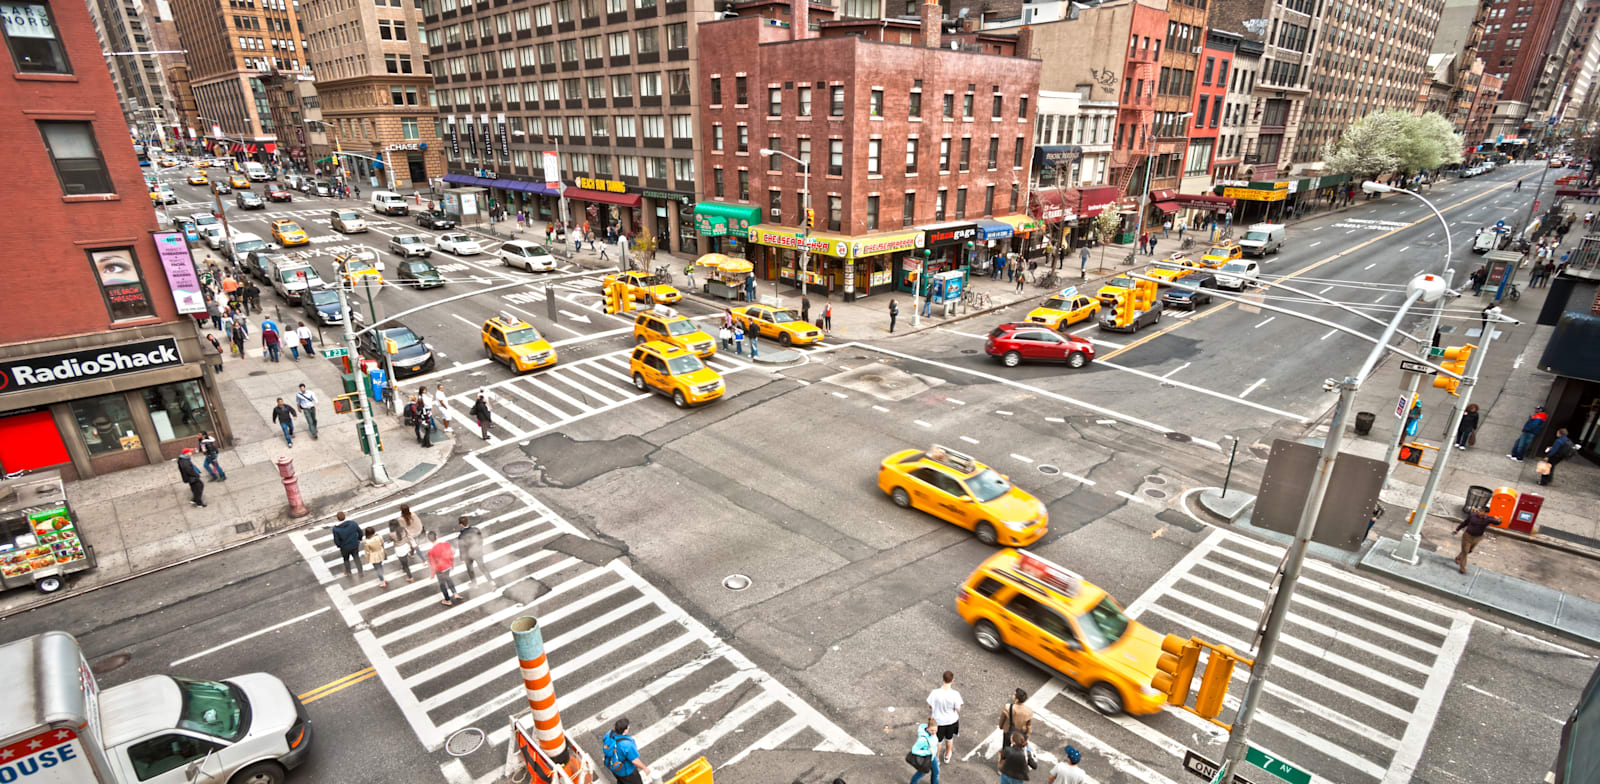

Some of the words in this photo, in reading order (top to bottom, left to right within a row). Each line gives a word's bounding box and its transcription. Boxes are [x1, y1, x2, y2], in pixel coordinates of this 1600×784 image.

[2, 16, 50, 27] NORD
[390, 143, 417, 151] CHASE
[763, 233, 796, 248] CHELSEA
[931, 231, 955, 244] pizza
[954, 229, 975, 240] gaga
[864, 242, 893, 254] CHELSEA
[11, 345, 178, 387] RadioShack
[1195, 762, 1218, 779] ONE
[1263, 754, 1275, 769] 7
[1279, 764, 1293, 774] AV
